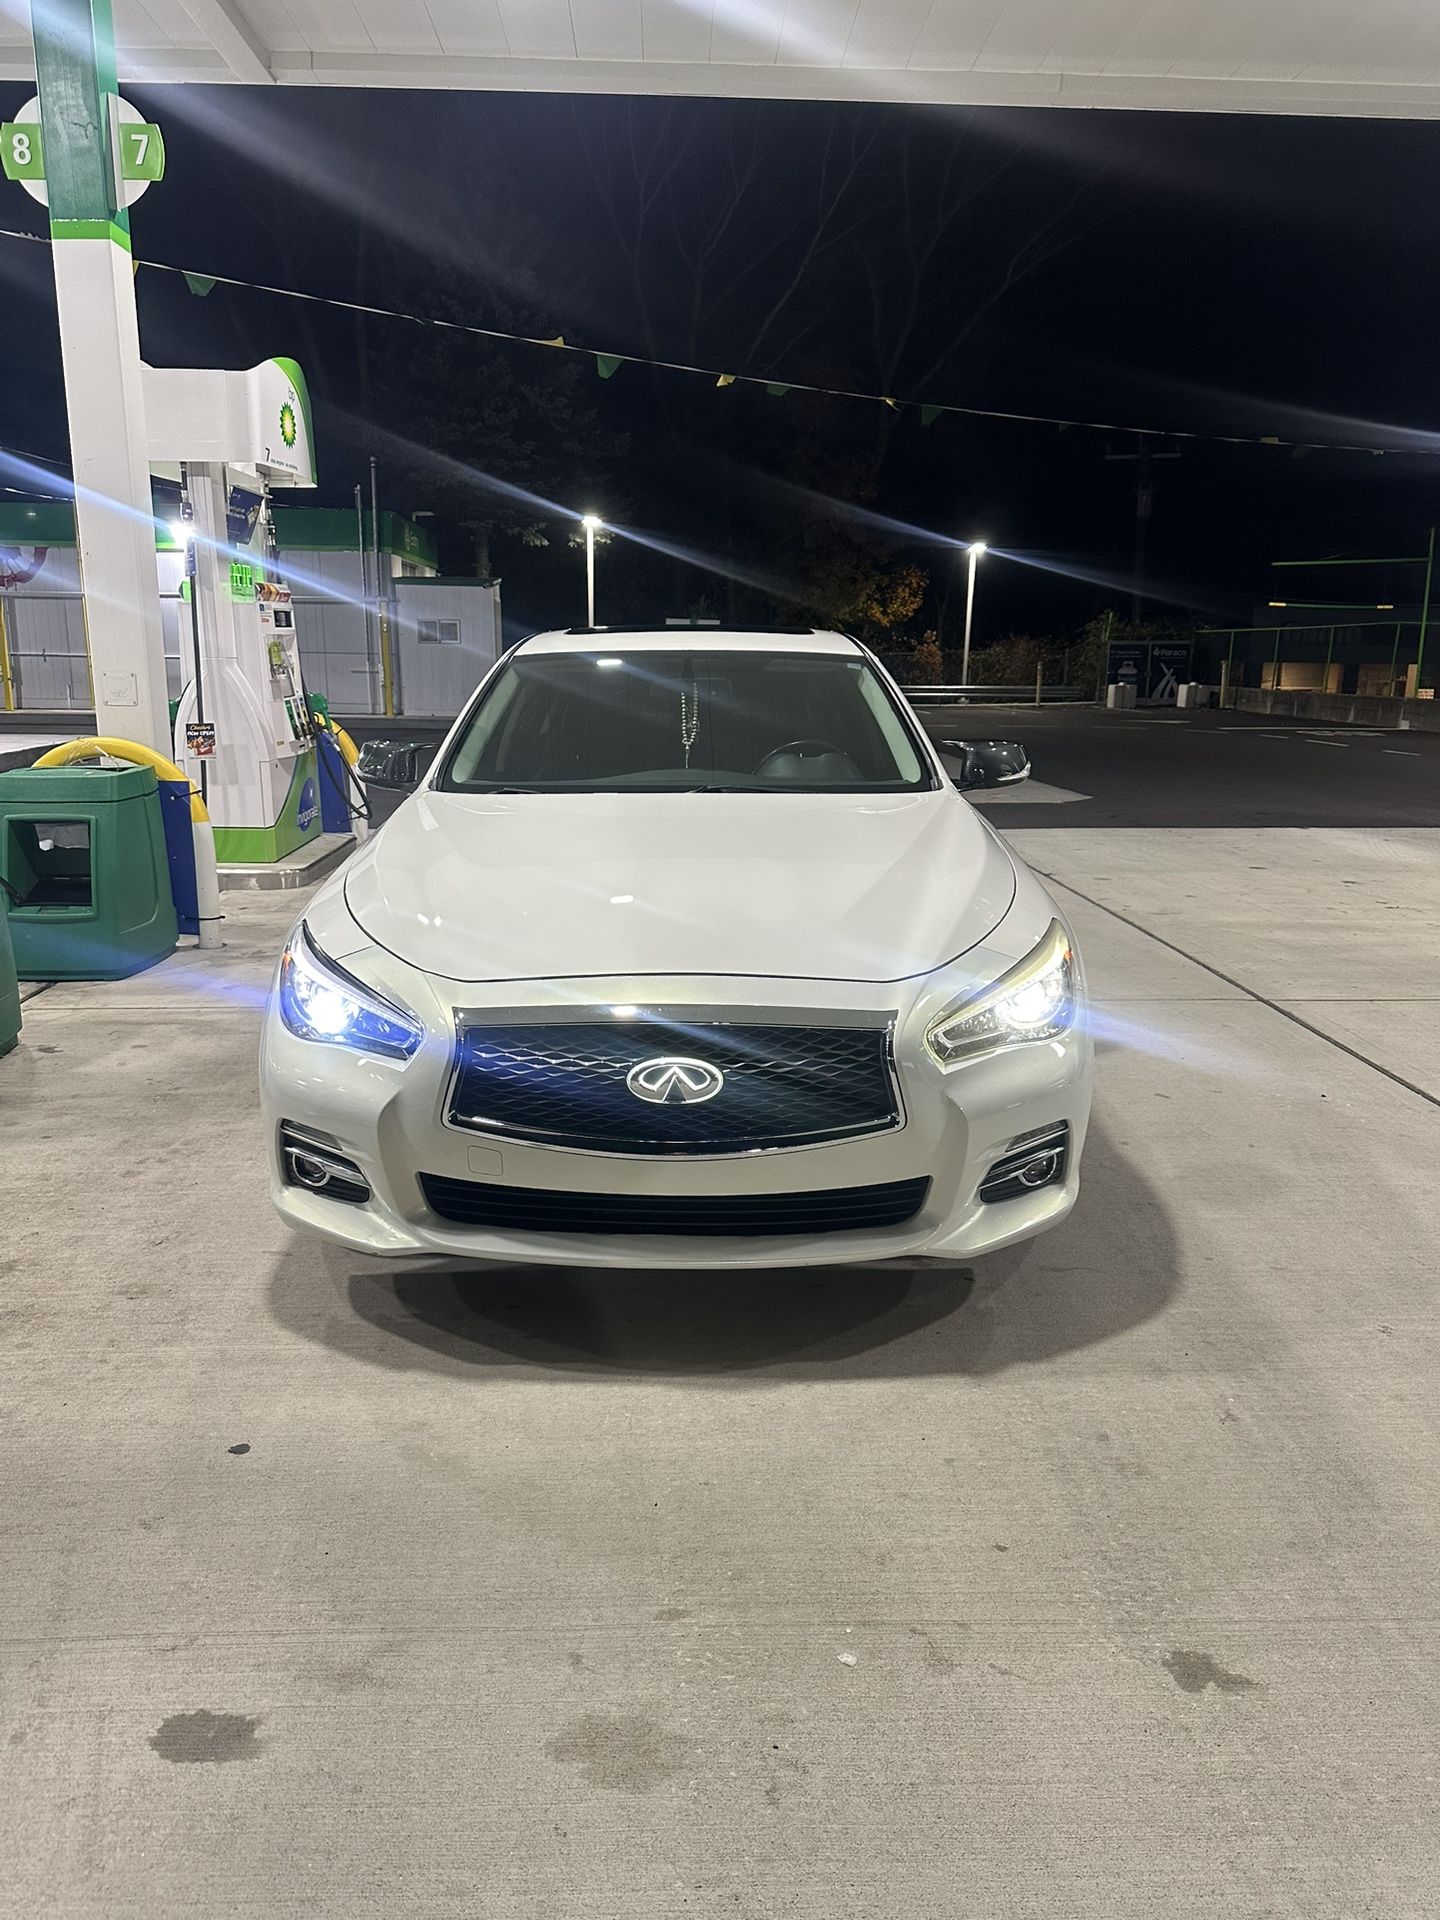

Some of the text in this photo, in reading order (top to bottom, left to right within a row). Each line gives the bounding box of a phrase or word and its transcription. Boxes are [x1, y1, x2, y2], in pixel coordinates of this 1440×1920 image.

[12, 133, 32, 165] 8
[130, 134, 149, 166] 7
[265, 447, 271, 462] 7
[1160, 648, 1187, 656] Paraco
